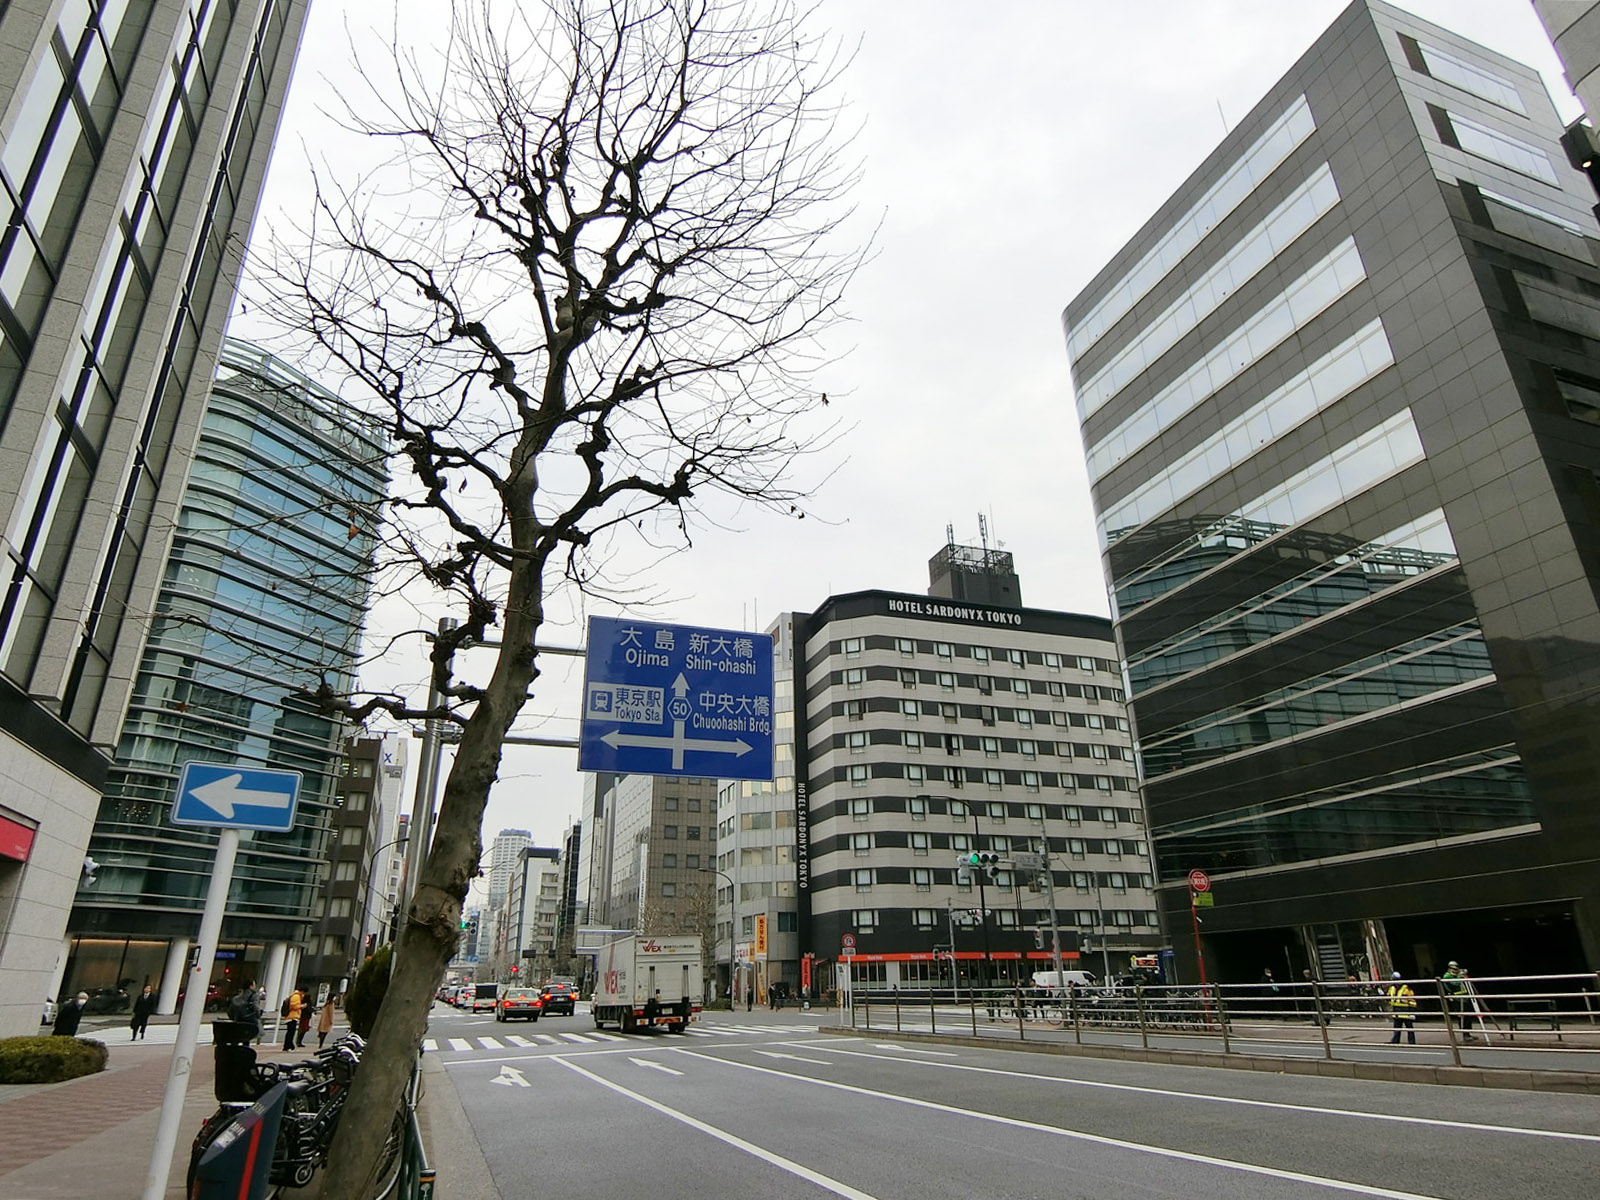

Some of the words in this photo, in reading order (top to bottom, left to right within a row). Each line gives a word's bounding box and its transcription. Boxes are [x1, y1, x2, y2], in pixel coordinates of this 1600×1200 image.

[888, 599, 923, 614] HOTEL
[925, 603, 984, 621] SARDONYX
[986, 611, 1022, 626] TOKYO
[620, 626, 675, 652] 大島
[689, 633, 754, 659] 新大橋
[625, 647, 669, 667] Ojima
[685, 654, 756, 675] Shin-ohashi
[615, 687, 662, 709] 東京駅
[672, 704, 687, 716] 50
[699, 690, 770, 717] 中央大橋
[614, 706, 642, 722] Tokyo
[644, 709, 662, 722] Sta.
[692, 712, 747, 732] Chuoohashi
[749, 719, 772, 736] Brdg.
[797, 782, 806, 808] HOTEL
[798, 810, 808, 856] SARDONYX
[799, 858, 808, 889] TOKYO
